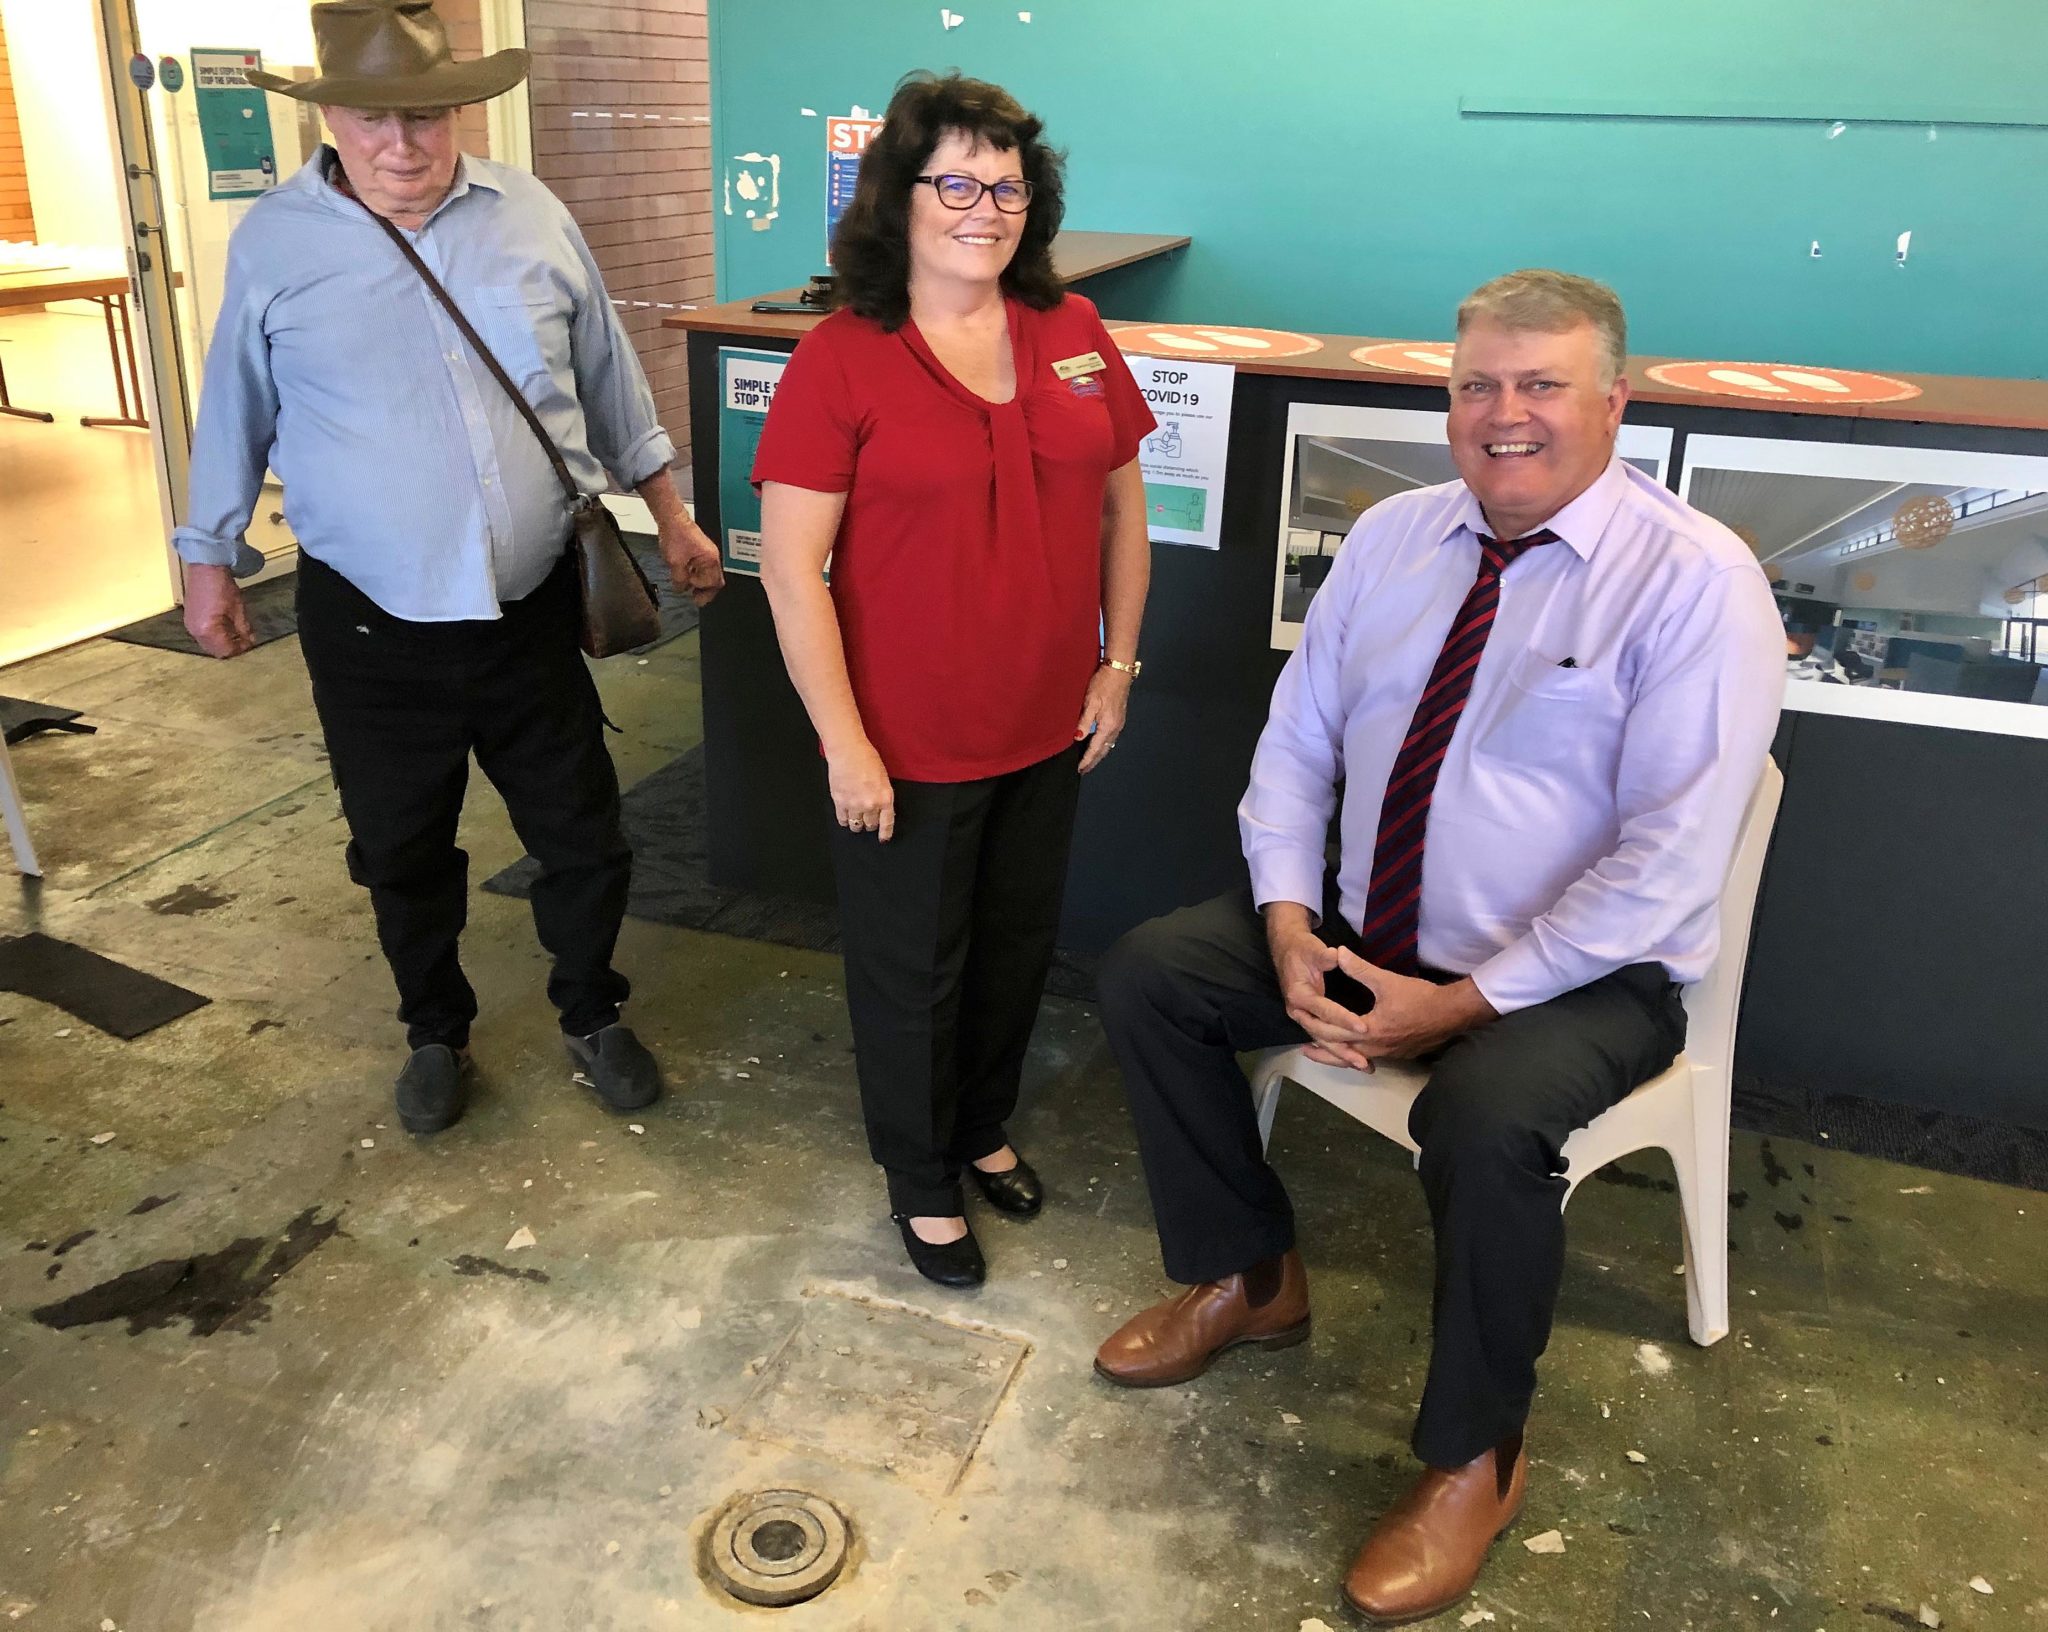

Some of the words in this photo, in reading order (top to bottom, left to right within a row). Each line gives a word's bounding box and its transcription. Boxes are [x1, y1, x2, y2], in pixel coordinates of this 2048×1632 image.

[200, 67, 218, 75] SIMPLE
[1152, 370, 1188, 385] STOP
[734, 378, 770, 393] SIMPLE
[734, 392, 759, 405] STOP
